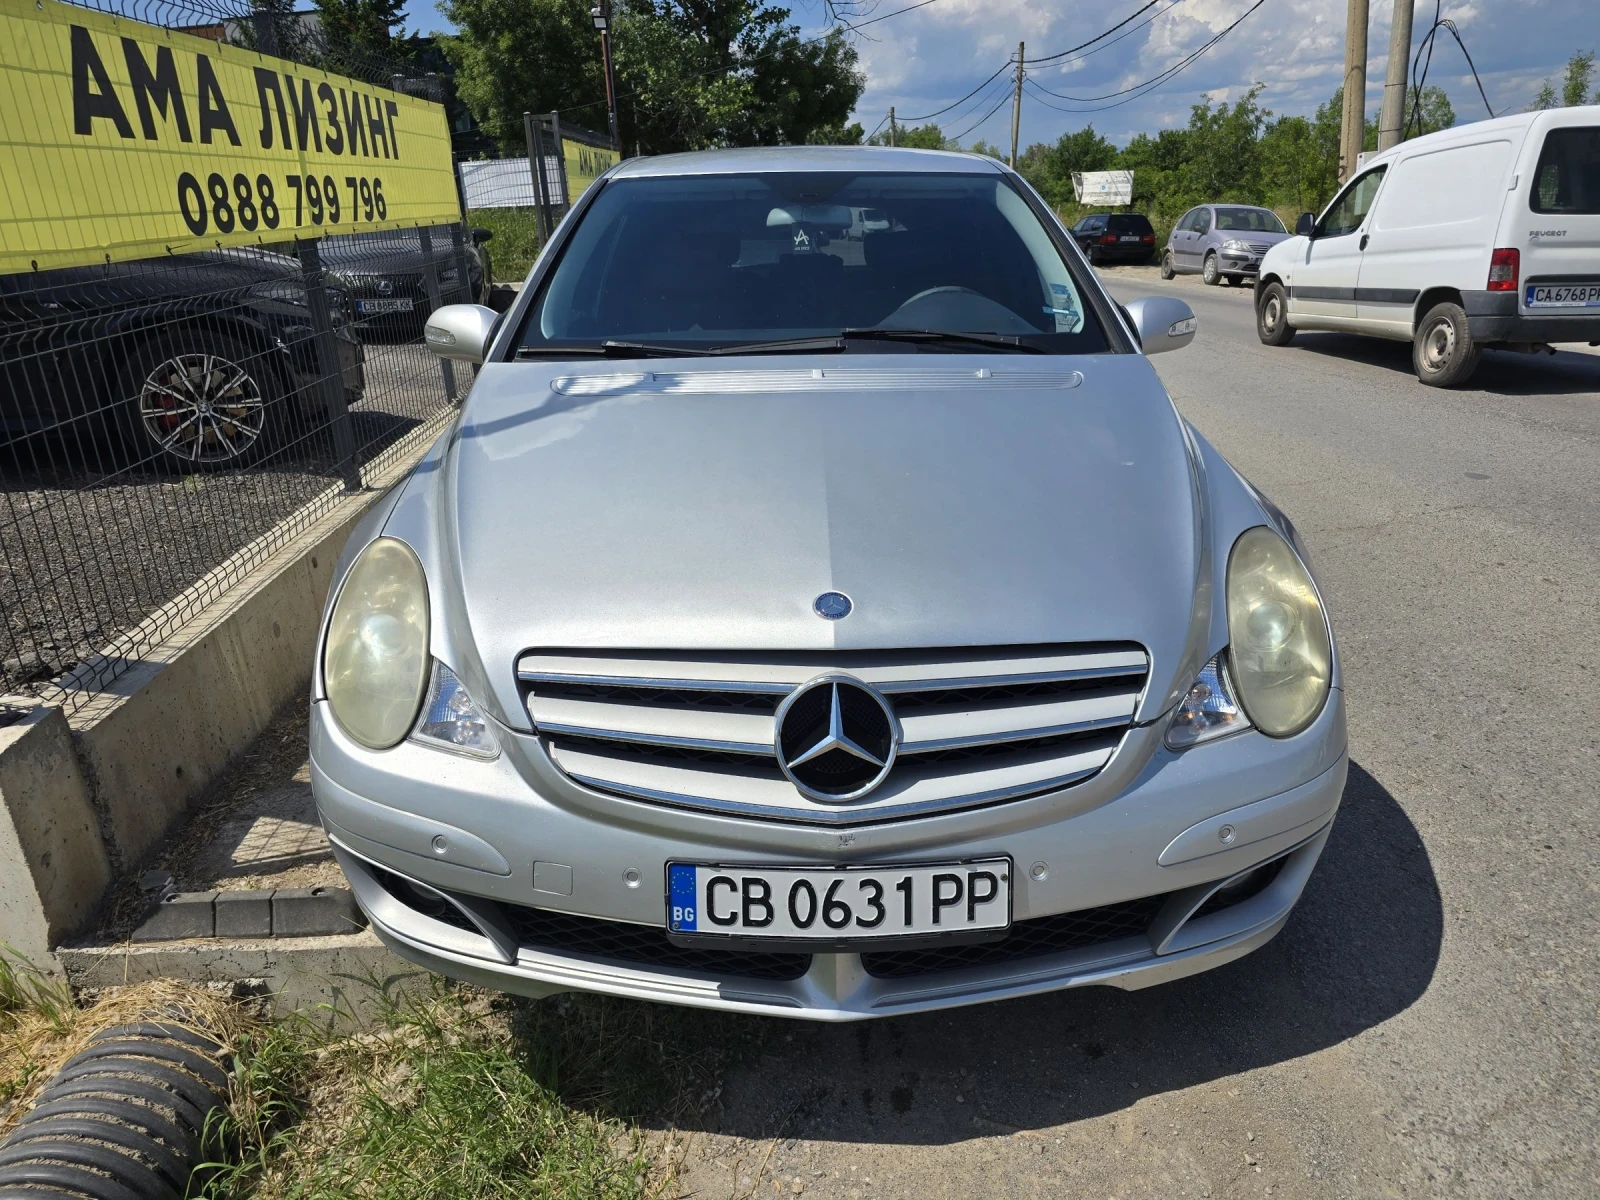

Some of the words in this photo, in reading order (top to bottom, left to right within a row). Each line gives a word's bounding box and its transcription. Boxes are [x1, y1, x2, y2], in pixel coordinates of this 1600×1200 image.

[70, 24, 242, 147] АМА
[253, 66, 399, 160] ЛИЗИНГ
[177, 171, 280, 237] 0888
[286, 174, 341, 227] 799
[345, 176, 387, 222] 796
[1536, 289, 1552, 302] CA
[1555, 288, 1587, 302] 6768
[673, 906, 694, 922] BG
[706, 875, 775, 928] CB
[788, 876, 914, 930] 0631
[931, 870, 999, 926] PP
